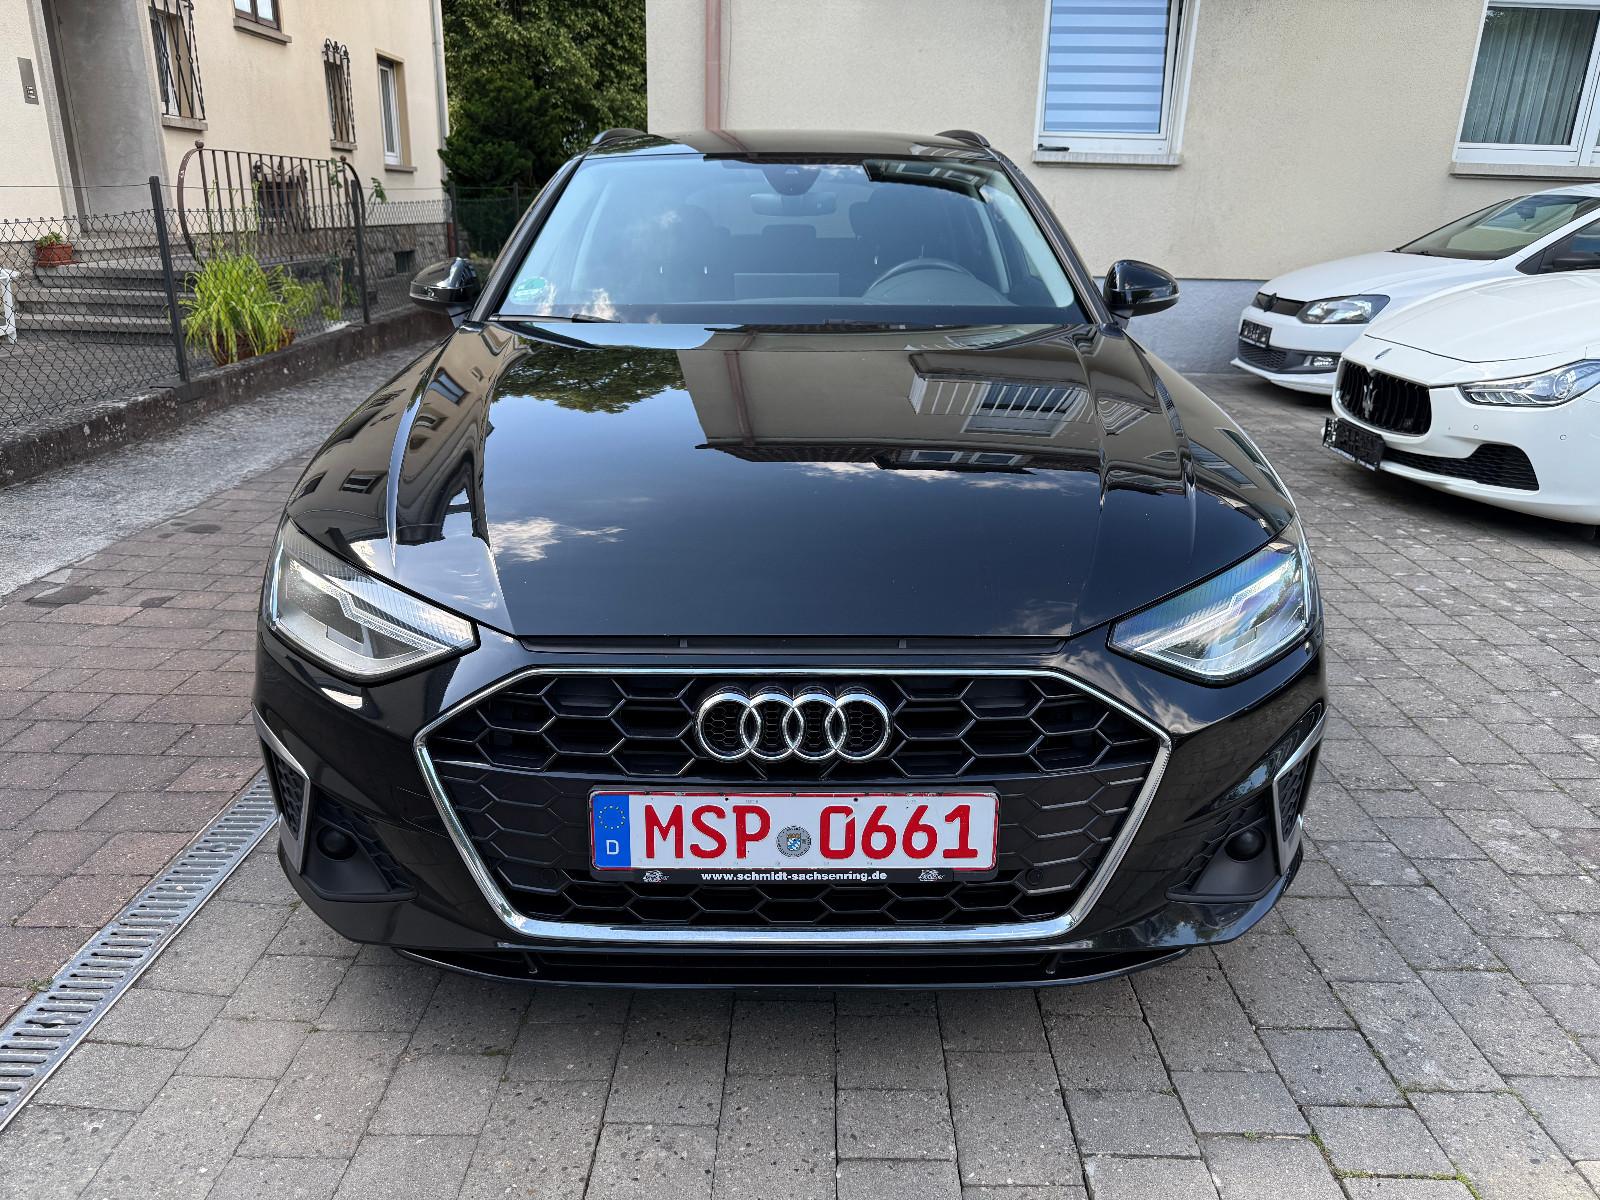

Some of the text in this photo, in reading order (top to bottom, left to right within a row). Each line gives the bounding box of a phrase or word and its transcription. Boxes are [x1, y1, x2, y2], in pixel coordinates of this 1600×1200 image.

[644, 804, 771, 860] MSP
[819, 804, 979, 860] 0661
[606, 840, 619, 855] D
[701, 870, 888, 882] www.schmidt-sachsenring.de
